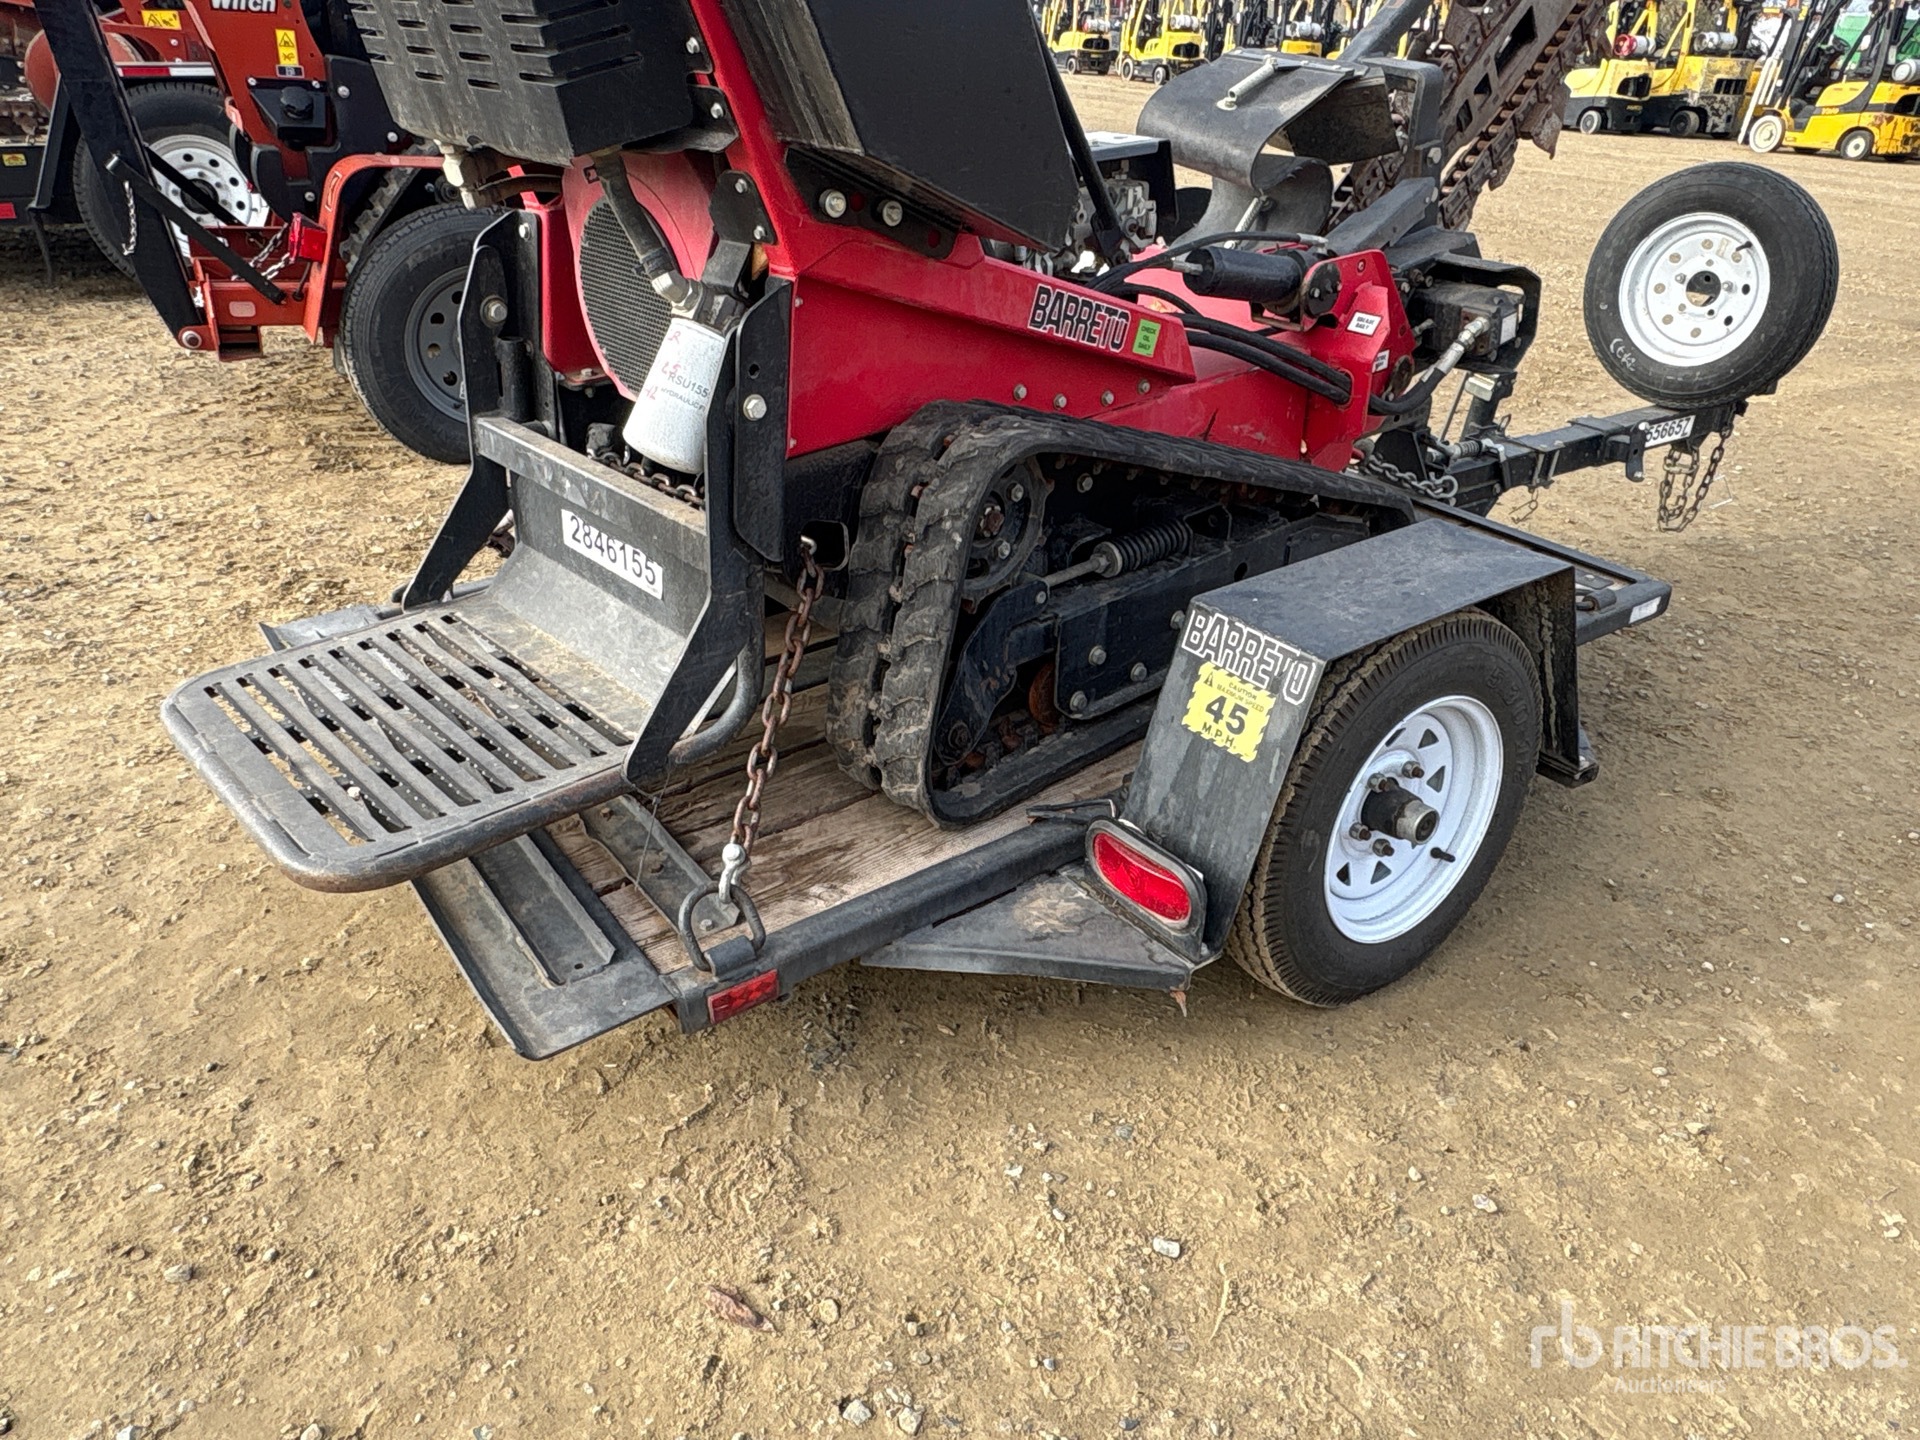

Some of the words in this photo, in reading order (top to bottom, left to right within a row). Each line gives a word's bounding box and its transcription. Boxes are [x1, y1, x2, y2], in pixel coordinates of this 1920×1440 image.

[1027, 283, 1131, 353] BARRETO
[569, 514, 656, 586] 2846155
[1182, 610, 1316, 705] BARRETO
[1205, 695, 1249, 735] 45
[1228, 682, 1258, 701] CAUTION
[1202, 721, 1237, 750] M.P.H.
